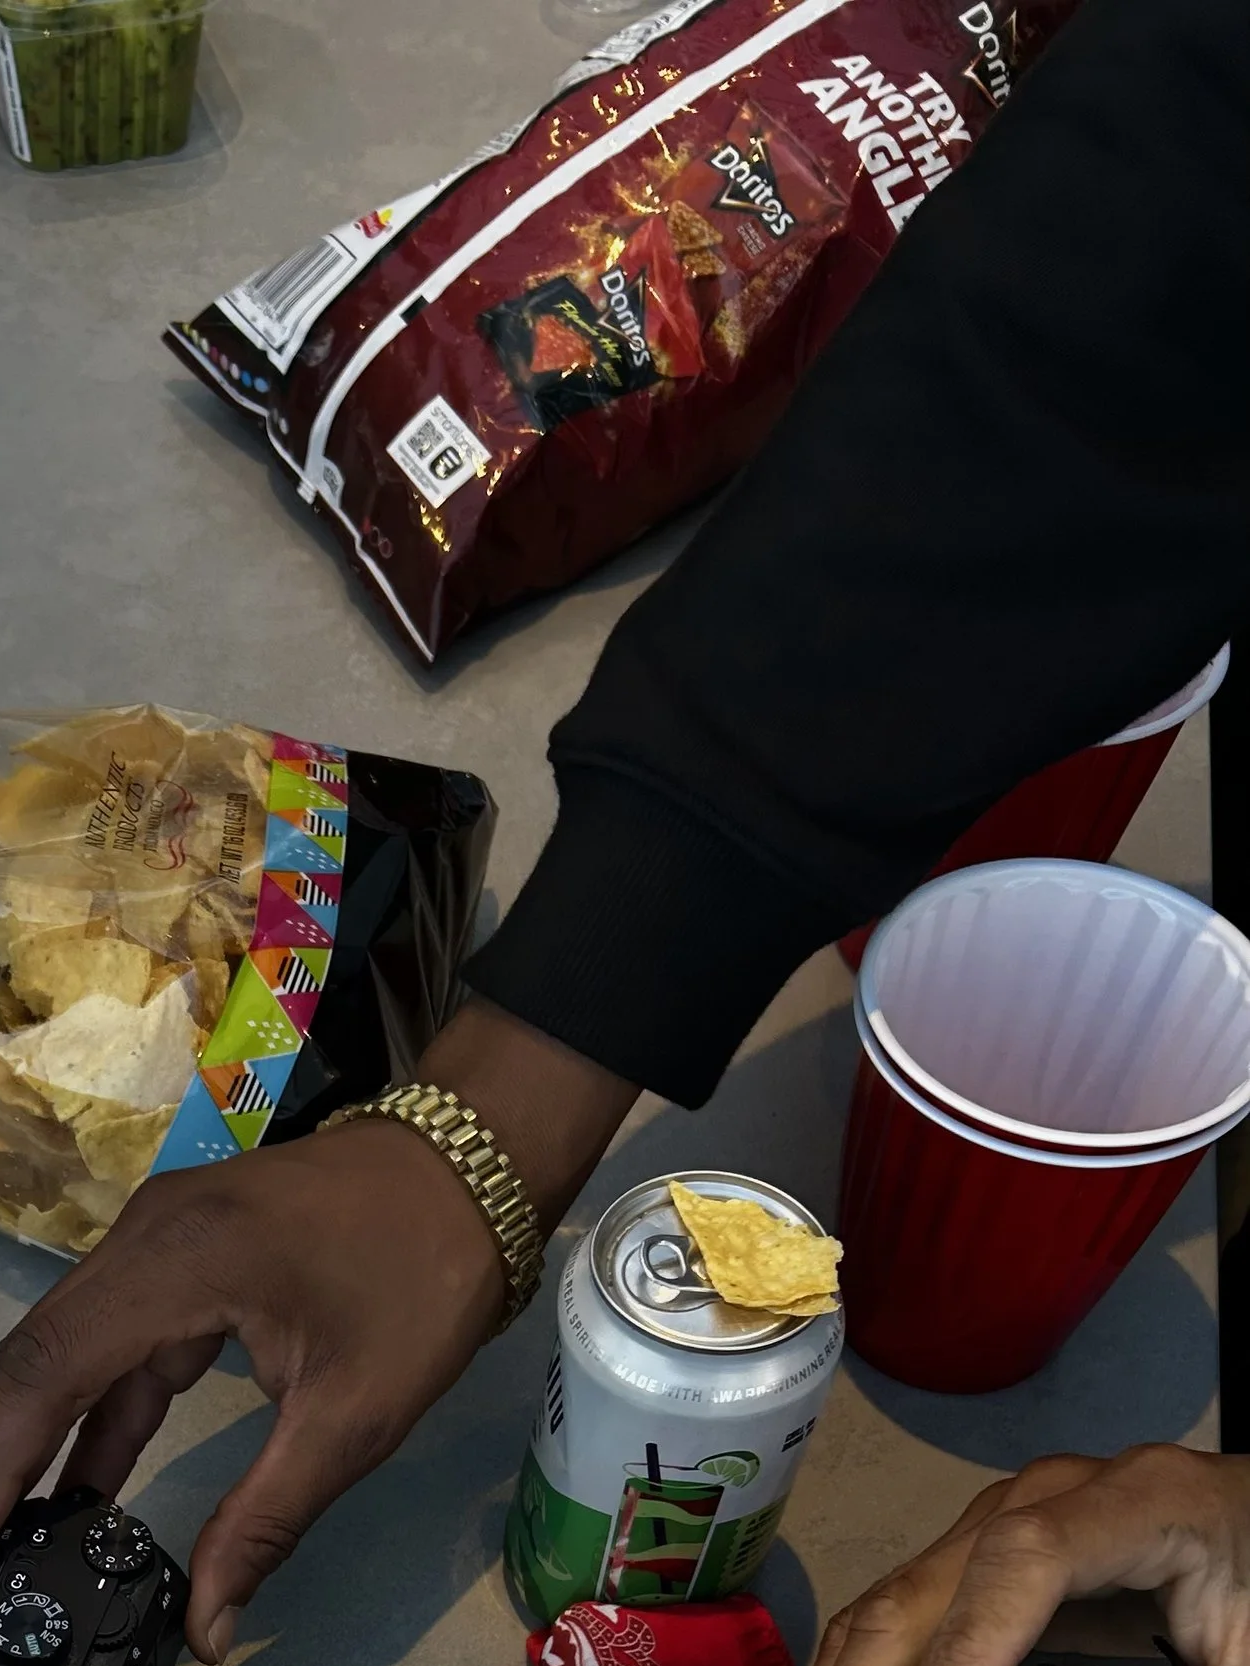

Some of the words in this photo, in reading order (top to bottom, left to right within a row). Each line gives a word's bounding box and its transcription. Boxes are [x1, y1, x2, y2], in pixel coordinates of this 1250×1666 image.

[904, 71, 973, 144] TRY
[711, 146, 795, 236] Doritos
[601, 269, 651, 368] Doritos
[85, 751, 128, 851] AUTHENTIC
[111, 780, 146, 853] PRODUCTS
[218, 863, 241, 885] NET
[221, 845, 242, 866] WT
[569, 1310, 605, 1362] SPIRITS
[613, 1361, 658, 1394] MADE
[660, 1381, 703, 1404] WITH
[31, 1528, 48, 1543] C1
[9, 1572, 28, 1590] C2
[9, 1643, 23, 1656] P
[38, 1629, 63, 1649] SCN
